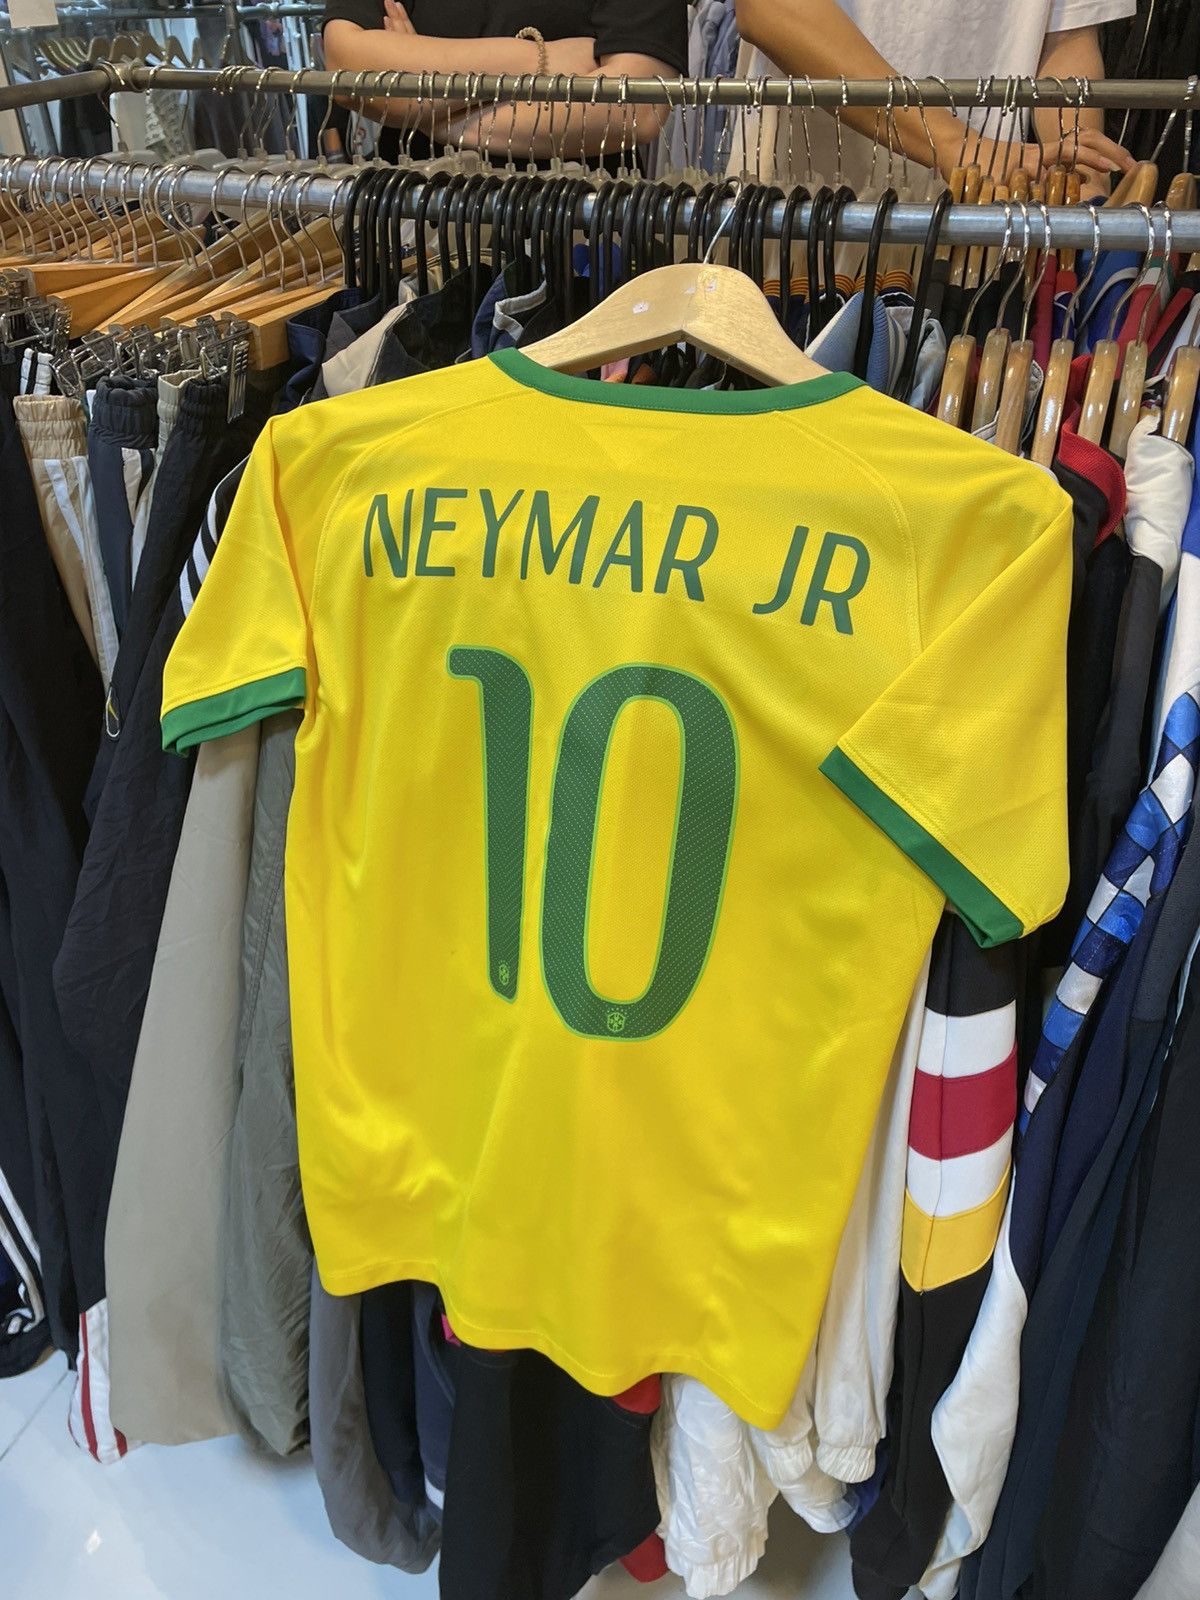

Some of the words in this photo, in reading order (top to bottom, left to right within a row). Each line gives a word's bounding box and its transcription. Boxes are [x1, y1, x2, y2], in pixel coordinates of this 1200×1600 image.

[363, 487, 718, 602] NEYMAR
[752, 525, 871, 635] JR
[447, 644, 741, 1042] 10
